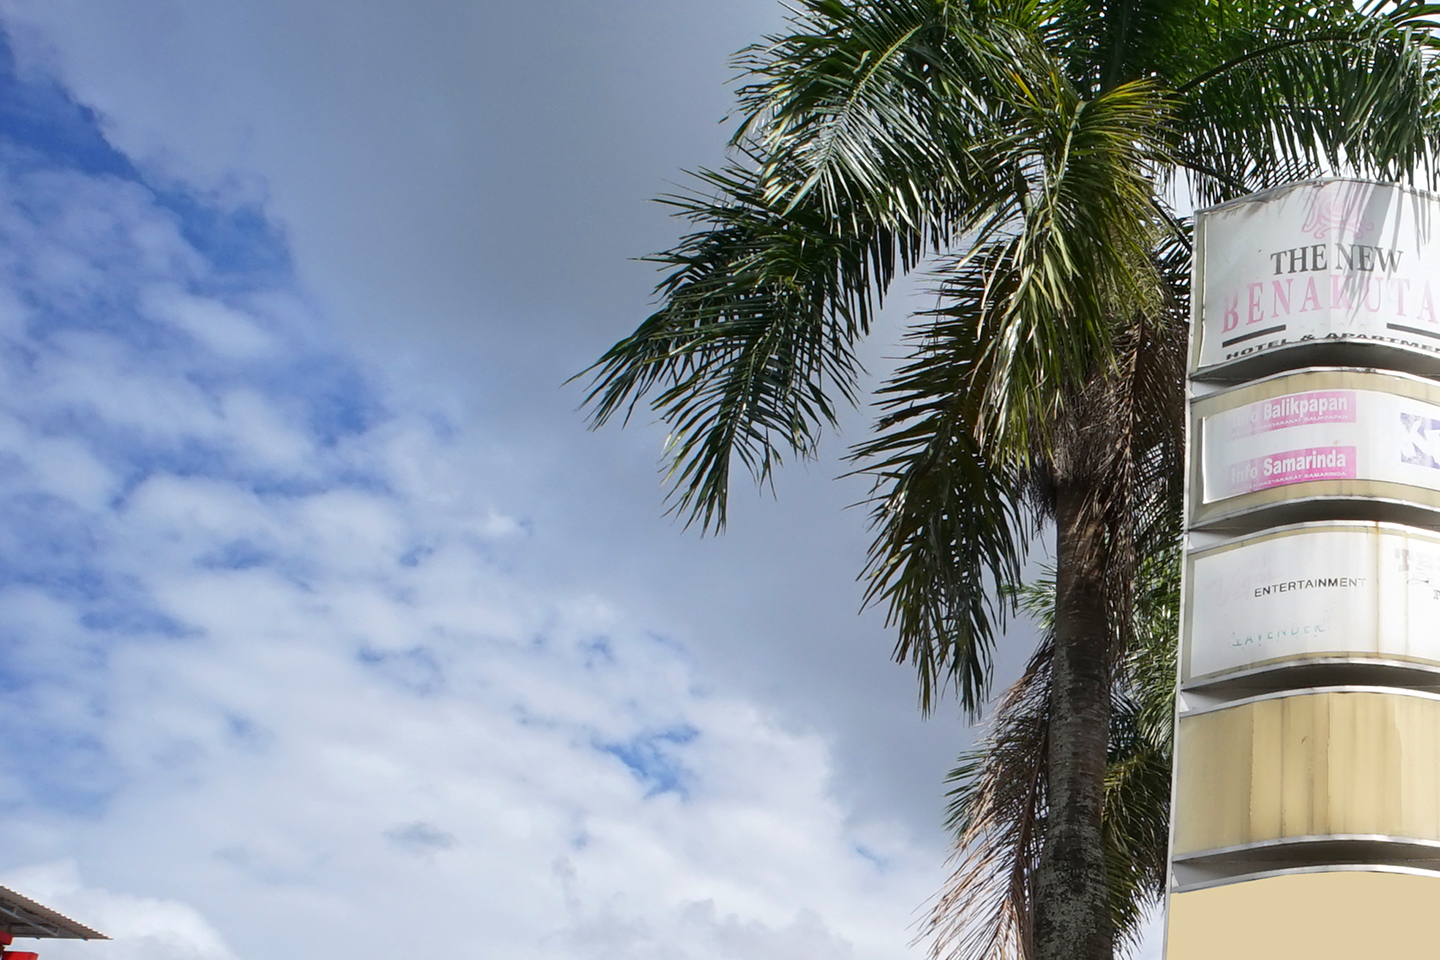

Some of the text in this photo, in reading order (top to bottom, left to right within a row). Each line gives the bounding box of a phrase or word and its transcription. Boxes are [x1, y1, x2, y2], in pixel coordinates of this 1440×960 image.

[1270, 243, 1404, 275] THE NEW
[1226, 338, 1288, 360] HOTEL
[1263, 396, 1348, 421] Balikpapan
[1263, 449, 1347, 478] Samarinda
[1254, 577, 1367, 598] ENTERTAINMENT
